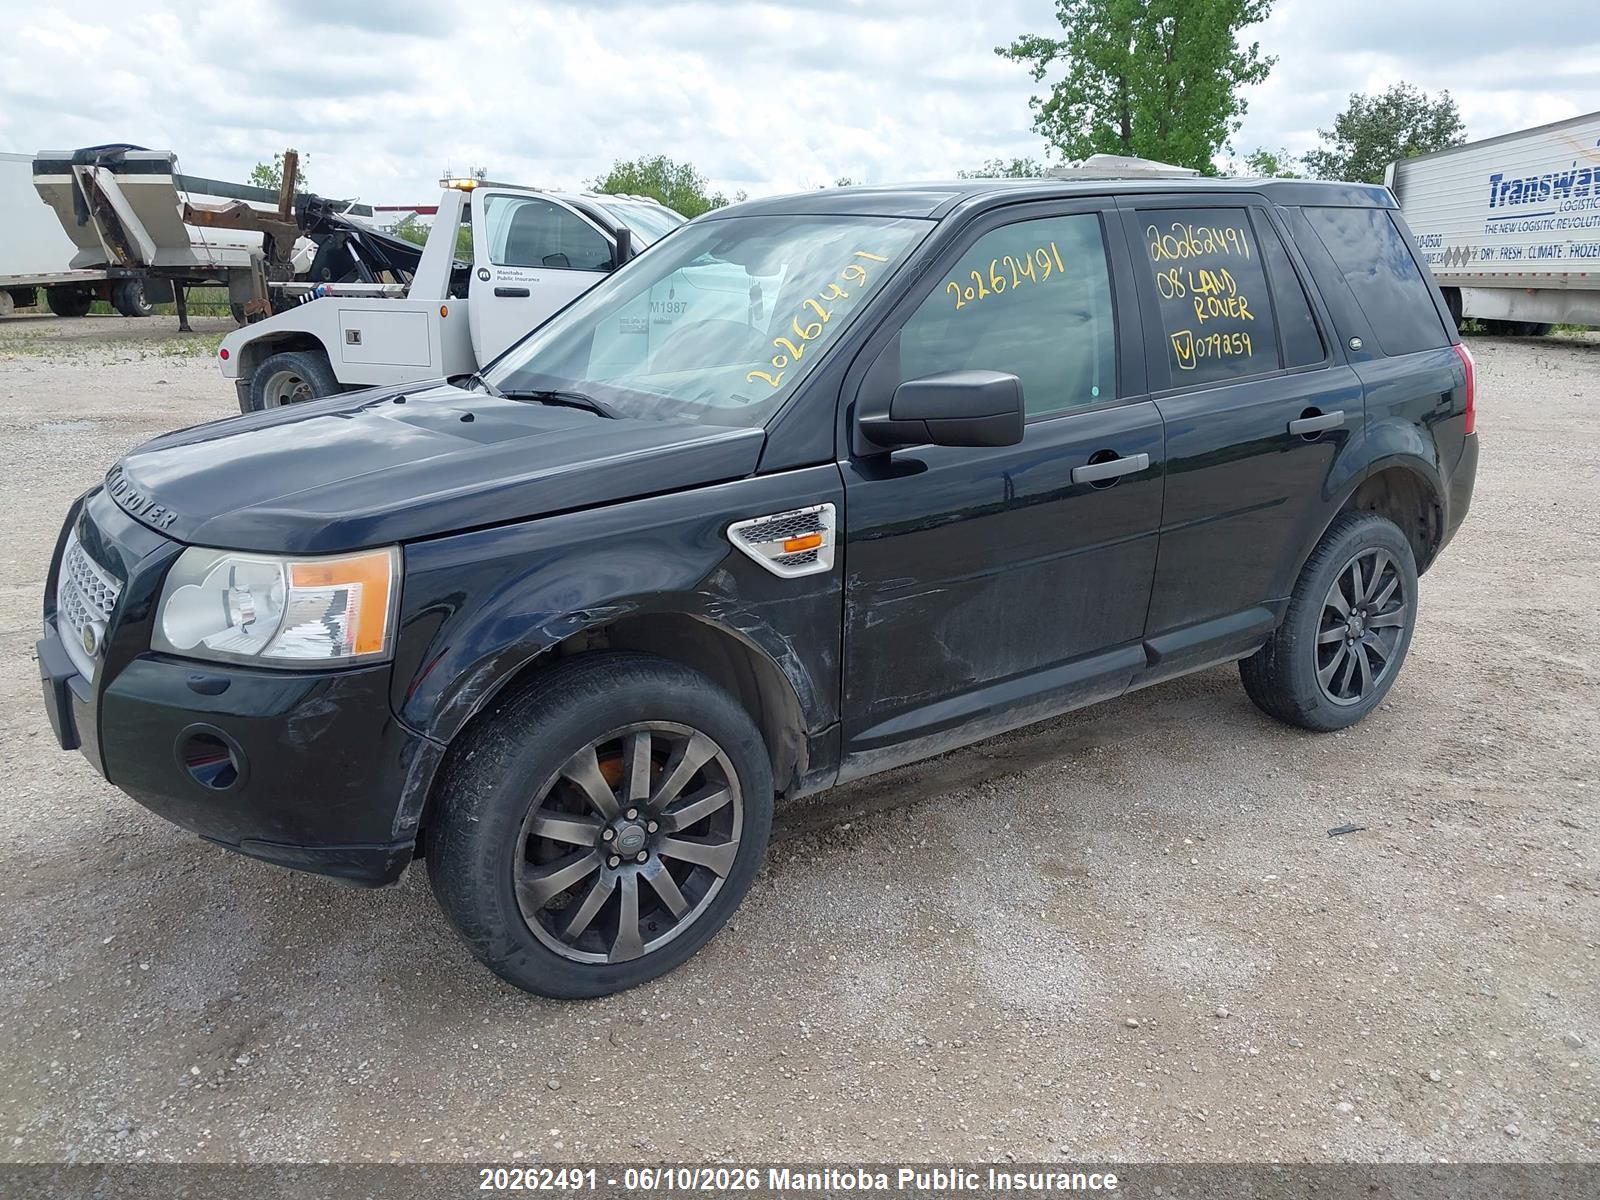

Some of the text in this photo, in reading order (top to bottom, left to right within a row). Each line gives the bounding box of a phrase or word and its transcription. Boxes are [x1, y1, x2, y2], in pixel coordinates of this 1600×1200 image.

[1147, 222, 1250, 262] 20262491
[1484, 224, 1498, 235] THE
[1499, 222, 1518, 234] NEW
[1480, 247, 1496, 260] DRY
[1500, 245, 1523, 260] FRESH
[1528, 244, 1564, 259] CLIMATE
[946, 241, 1065, 310] 20262491
[1188, 268, 1237, 296] LAND
[650, 301, 688, 313] M1987
[746, 250, 889, 387] 20262491
[1194, 296, 1255, 324] ROVER
[121, 488, 178, 530] ROVER
